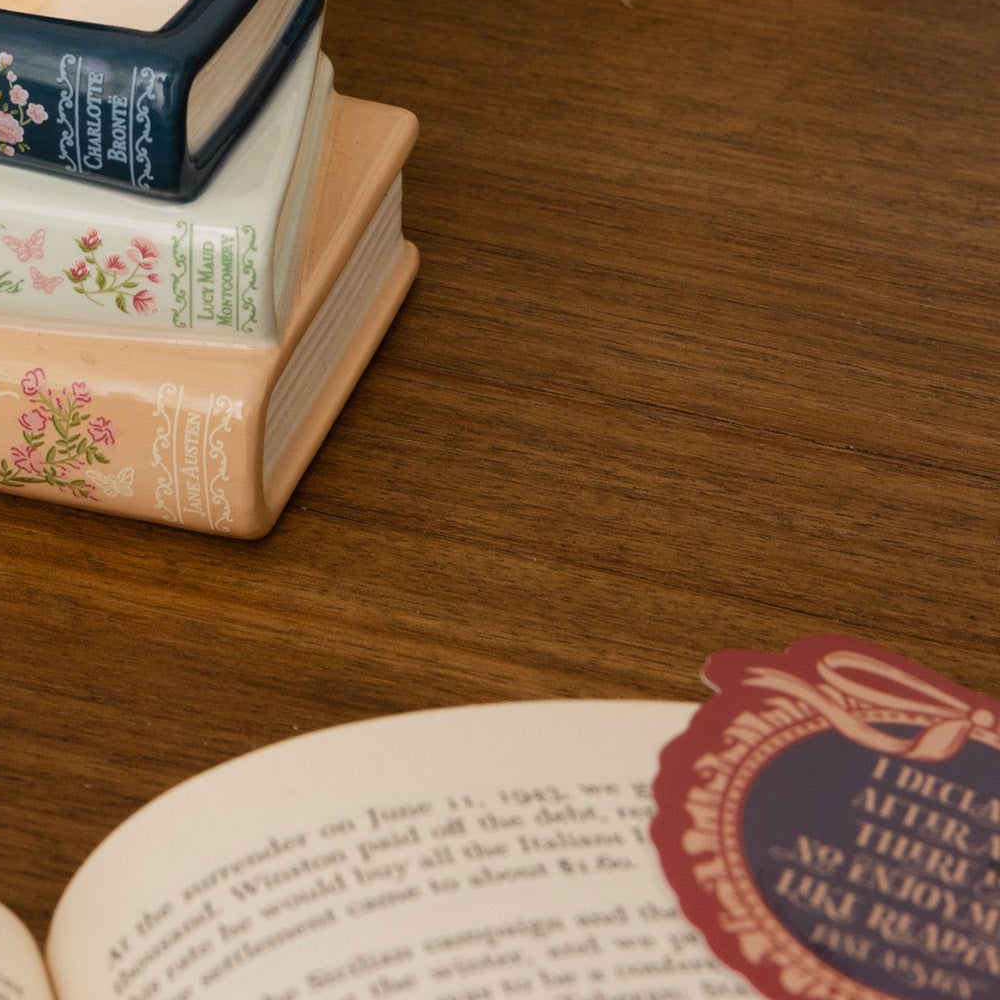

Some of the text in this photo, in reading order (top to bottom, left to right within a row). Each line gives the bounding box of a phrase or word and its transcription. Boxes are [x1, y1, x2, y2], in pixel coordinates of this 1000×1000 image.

[83, 72, 104, 170] CHARLOTTE
[107, 95, 128, 164] BRONTË
[197, 240, 215, 321] LUCY MAUD
[180, 411, 207, 517] JANE AUSTEN
[871, 756, 890, 781] I
[182, 834, 305, 901] surrender
[318, 819, 356, 838] on
[366, 803, 432, 830] June
[851, 785, 971, 850] AFTER
[230, 850, 348, 901] Winston
[356, 825, 419, 863] paid
[430, 816, 466, 838] off
[478, 813, 523, 831] the
[257, 871, 347, 919] would
[352, 861, 409, 885] buy
[420, 846, 456, 868] all
[462, 841, 507, 861] the
[428, 876, 461, 894] to
[468, 864, 549, 890] about
[855, 820, 970, 886] THERE
[545, 934, 600, 959] and
[574, 904, 630, 926] and
